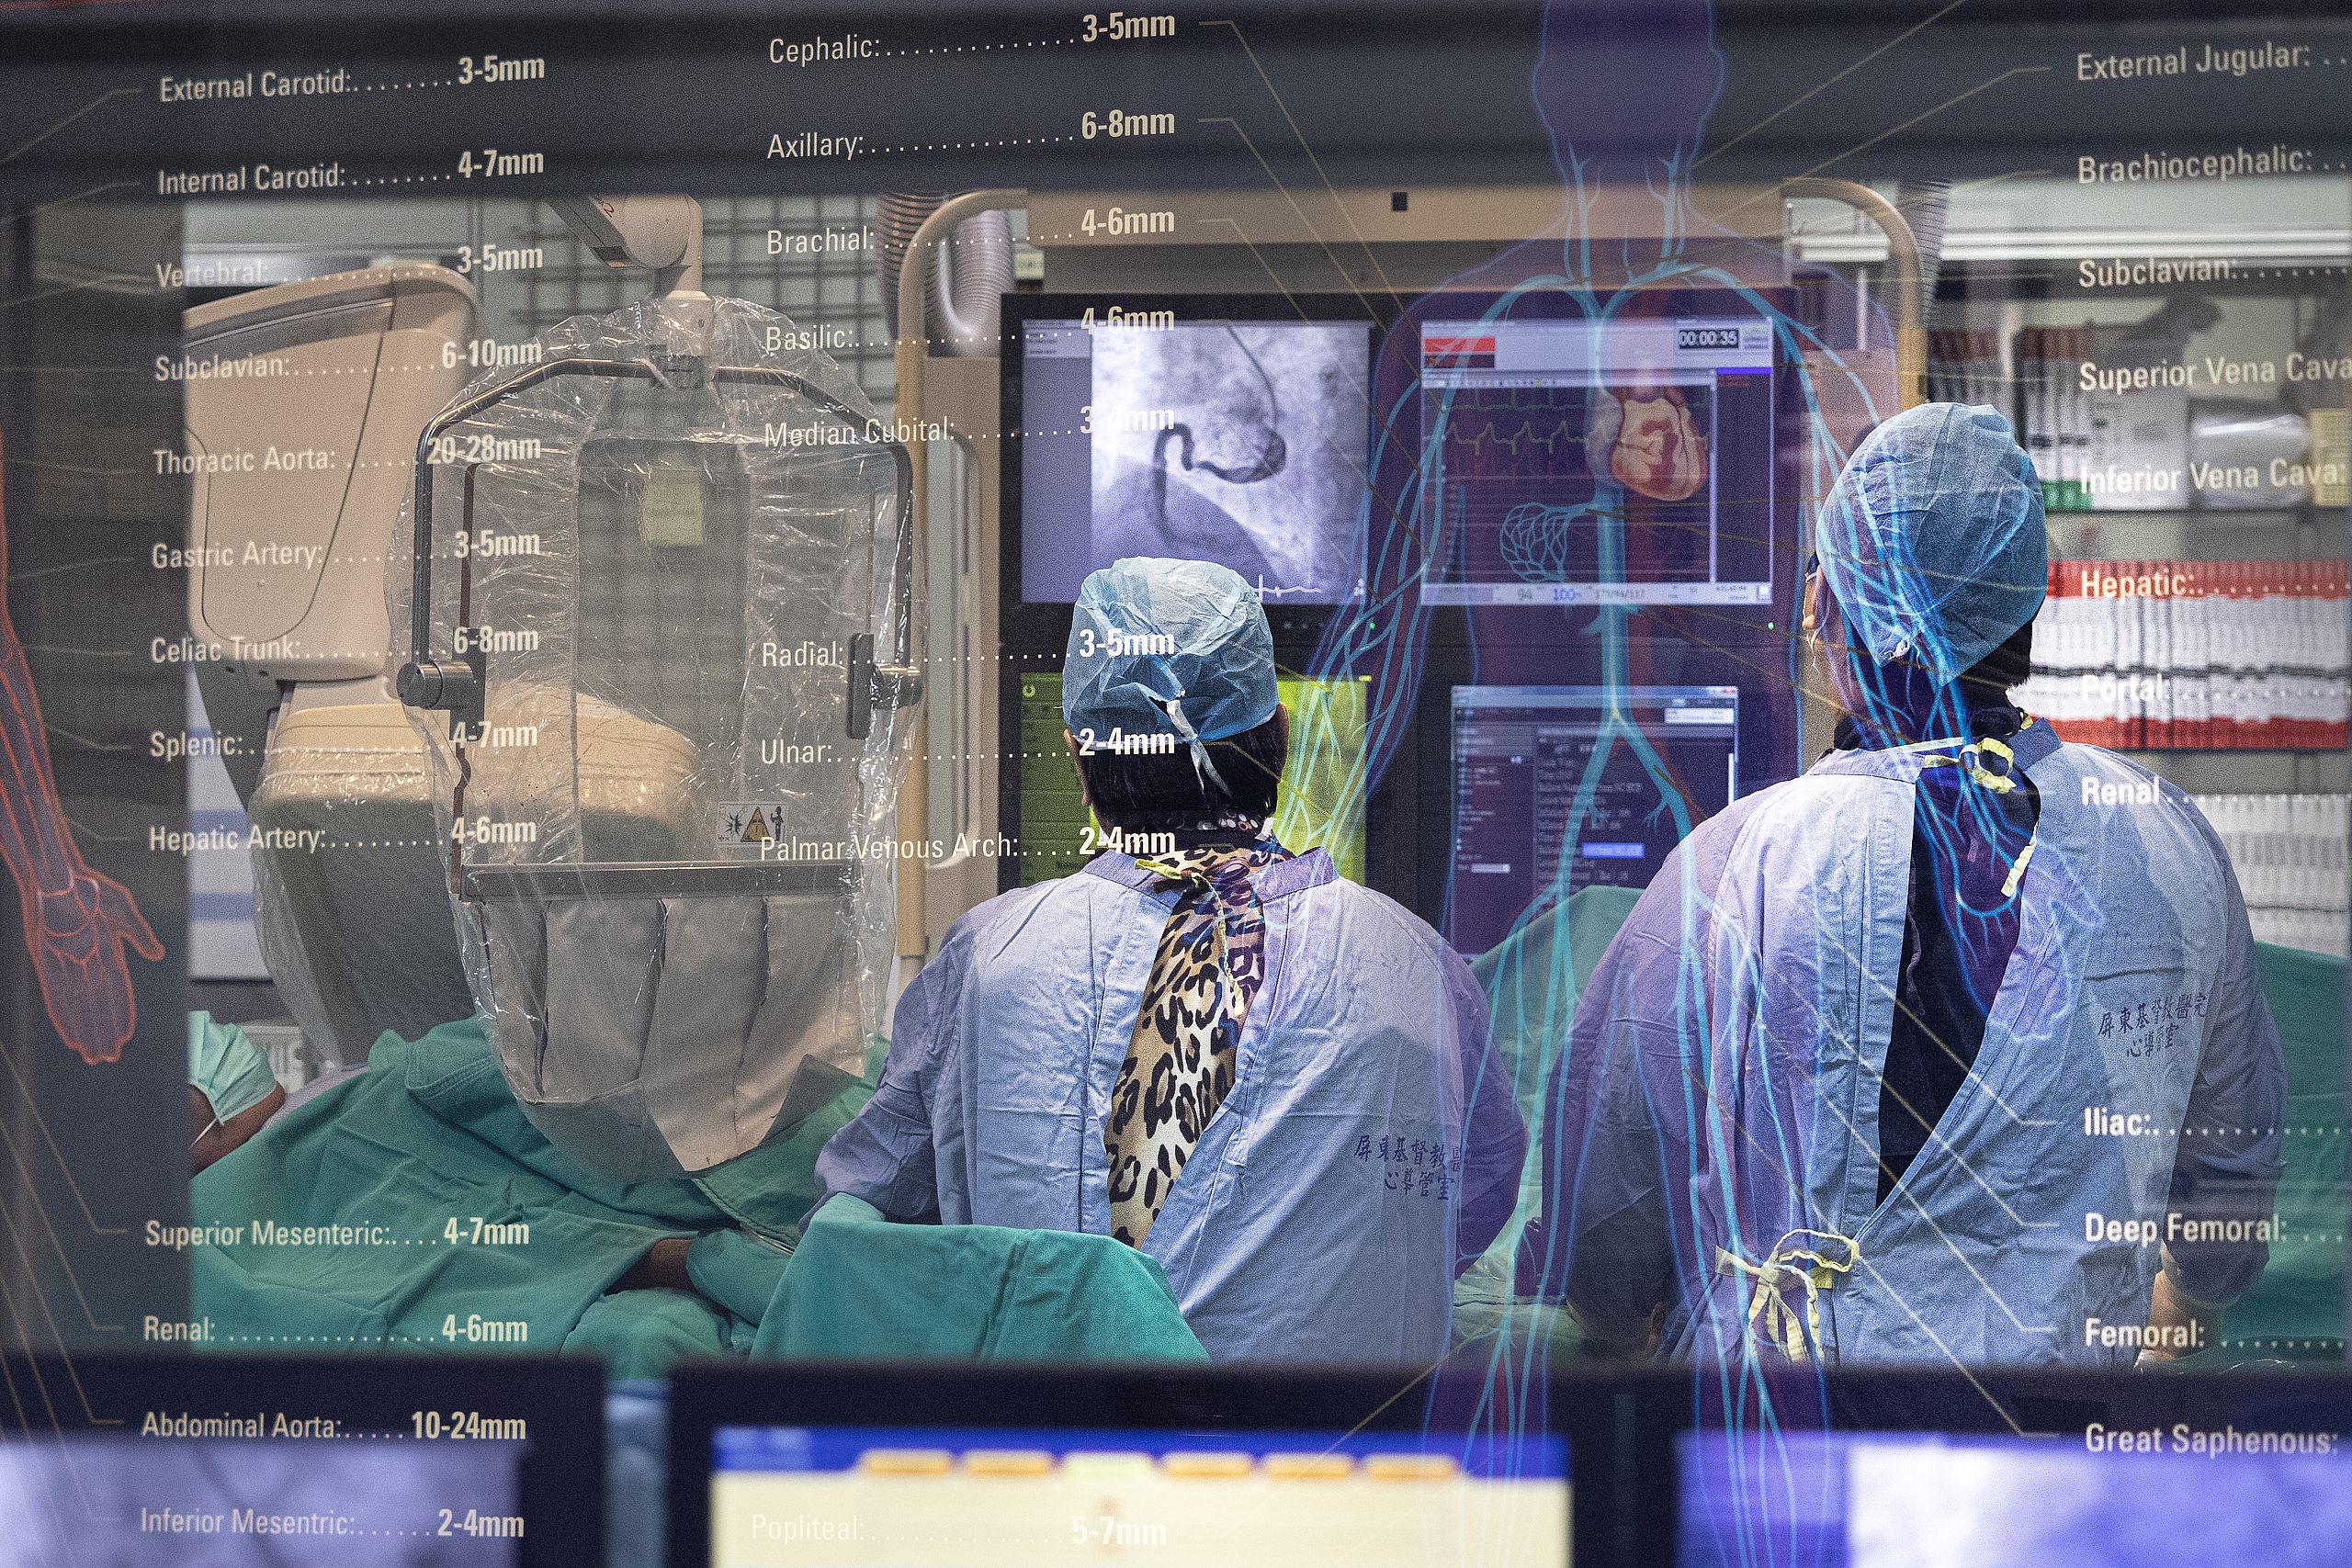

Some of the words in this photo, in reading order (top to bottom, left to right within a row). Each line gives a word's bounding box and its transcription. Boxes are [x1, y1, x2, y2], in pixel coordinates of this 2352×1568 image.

[768, 33, 881, 67] Cephalic:
[1082, 12, 1175, 43] 3-5mm
[160, 73, 253, 102] External
[261, 69, 351, 97] Carotid:
[458, 55, 545, 85] 3-5mm
[2077, 47, 2187, 81] External
[2196, 41, 2311, 79] Jugular:
[767, 131, 865, 163] Axillary:
[1081, 109, 1175, 141] 6-8mm
[158, 168, 246, 195] Internal
[254, 164, 346, 190] Carotid:
[458, 150, 545, 180] 4-7mm
[2078, 146, 2312, 185] Brachiocephalic:
[767, 226, 876, 255] Brachial:
[1080, 208, 1175, 237] 4-6mm
[156, 260, 270, 289] Vertebral:
[457, 245, 544, 275] 3-5mm
[2079, 256, 2238, 288] Subclavian:
[766, 324, 854, 353] Basilic:
[1080, 306, 1175, 335] 4-6mm
[155, 354, 291, 382] Subclavian:
[442, 340, 542, 368] 6-10mm
[2079, 362, 2196, 395] Superior
[2205, 358, 2276, 385] Vena
[764, 420, 856, 448] Median
[865, 416, 956, 444] Cubital:
[154, 449, 254, 476] Thoracic
[265, 446, 336, 471] Aorta:
[425, 436, 541, 465] 20-28mm
[2080, 465, 2180, 495] Inferior
[2189, 463, 2259, 491] Vena
[2269, 459, 2346, 488] Cava:
[152, 543, 234, 570] Gastric
[242, 539, 322, 571] Artery:
[455, 532, 539, 559] 3-5mm
[2081, 570, 2197, 603] Hepatic:
[152, 637, 221, 664] Celiac
[230, 635, 300, 660] Trunk:
[453, 626, 539, 654] 6-8mm
[762, 640, 843, 668] Radial:
[1080, 630, 1176, 659] 3-5mm
[151, 731, 243, 763] Splenic:
[452, 720, 537, 749] 4-7mm
[762, 739, 833, 765] Ulnar:
[1079, 728, 1176, 757] 2-4mm
[150, 825, 239, 855] Hepatic
[247, 824, 327, 855] Artery:
[450, 816, 537, 843] 4-6mm
[761, 835, 847, 863] Palmar
[854, 834, 944, 861] Venous
[953, 831, 1019, 858] Arch:
[1079, 826, 1176, 856] 2-4mm
[2085, 1108, 2151, 1137] Iliac:
[145, 1220, 244, 1253] Superior
[252, 1220, 391, 1247] Mesenteric:
[444, 1217, 529, 1246] 4-7mm
[2086, 1213, 2161, 1246] Deep
[2167, 1213, 2288, 1243] Femoral:
[143, 1315, 216, 1343] Renal:
[442, 1314, 528, 1342] 4-6mm
[2086, 1318, 2205, 1348] Femoral:
[141, 1412, 264, 1439] Abdominal
[271, 1413, 343, 1439] Aorta:
[412, 1411, 526, 1440] 10-24mm
[2086, 1425, 2162, 1454] Great
[2172, 1424, 2338, 1459] Saphenous:
[141, 1507, 224, 1535] Inferior
[232, 1508, 356, 1537] Mesentric:
[437, 1508, 525, 1539] 2-4mm
[752, 1513, 865, 1550] Popliteal:
[1072, 1515, 1167, 1547] 5-7mm
